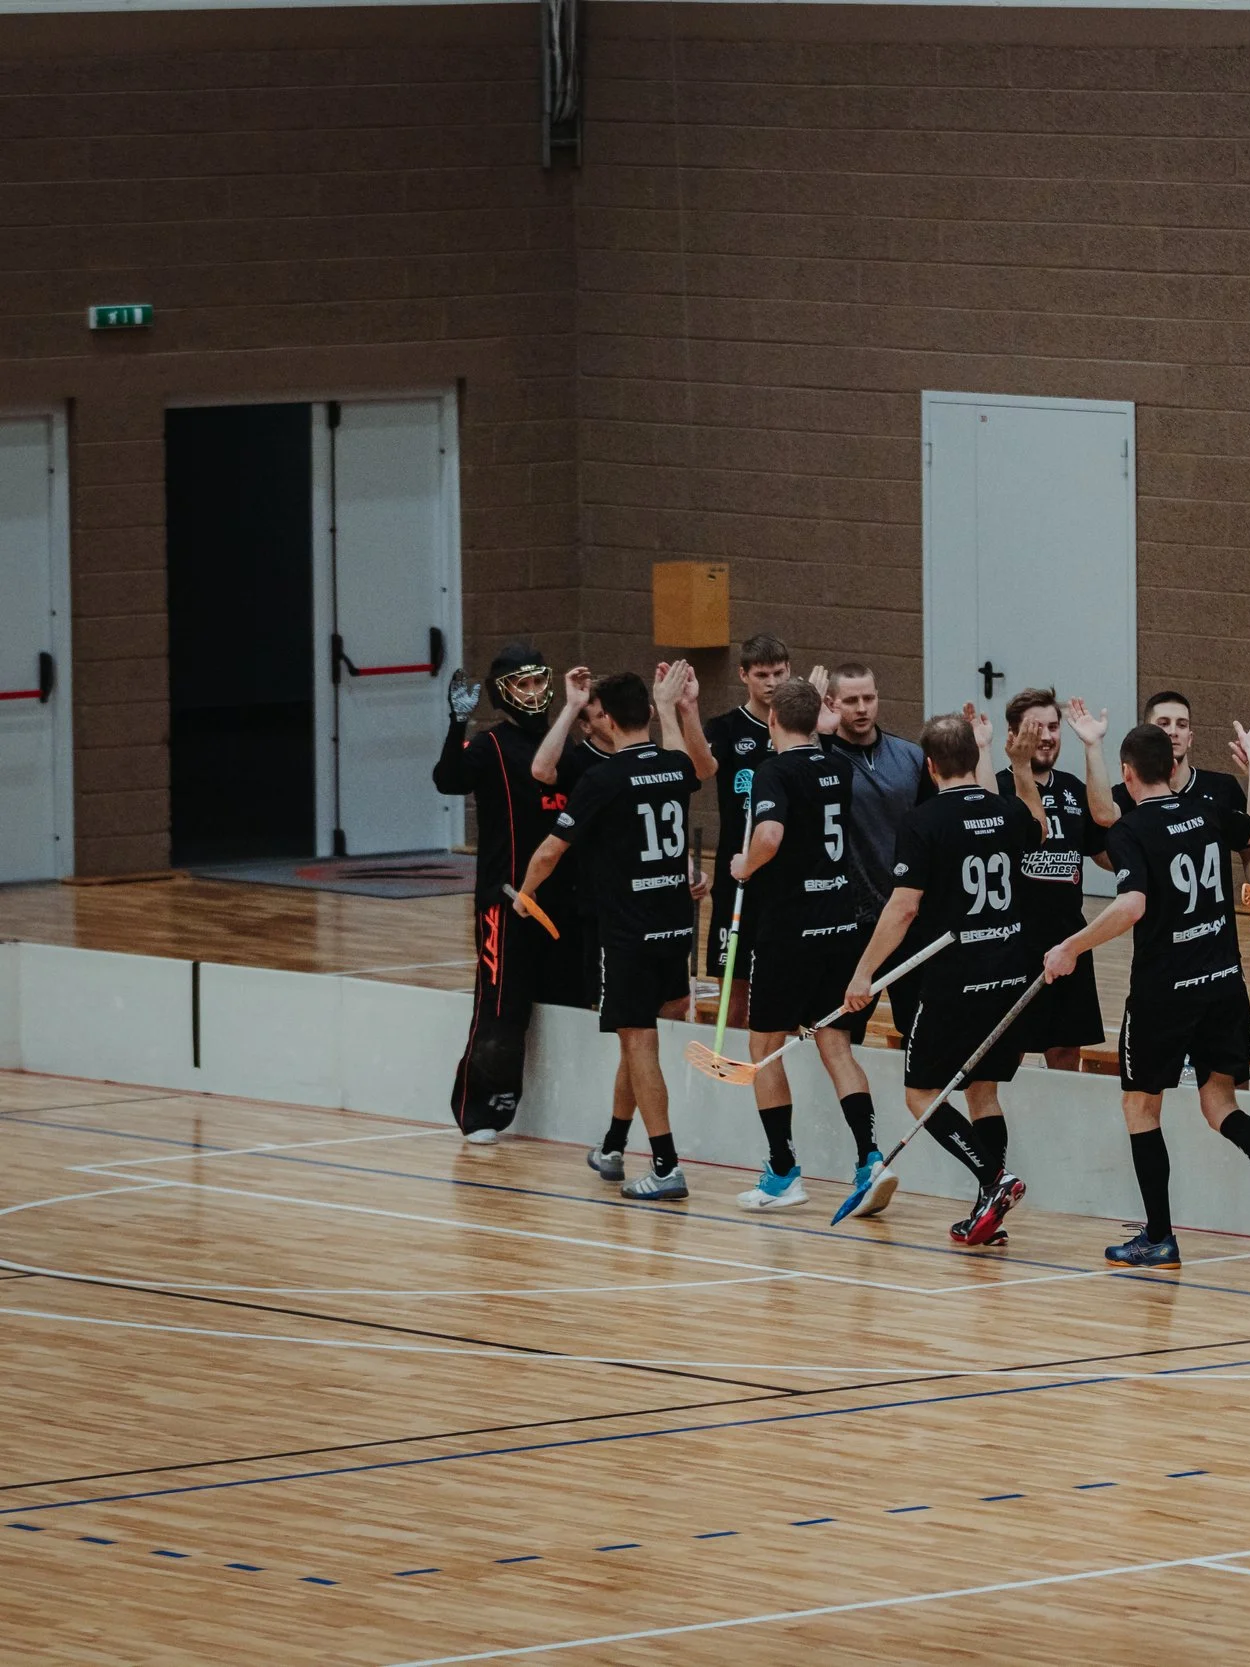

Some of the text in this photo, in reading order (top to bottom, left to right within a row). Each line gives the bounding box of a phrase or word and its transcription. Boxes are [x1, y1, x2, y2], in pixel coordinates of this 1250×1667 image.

[739, 741, 755, 752] KSC
[638, 800, 684, 861] 13
[964, 816, 1004, 830] BRIEDIS
[1167, 817, 1204, 834] KOKINS
[825, 804, 843, 861] 5
[962, 852, 1011, 915] 93
[1170, 842, 1224, 914] 94
[643, 930, 674, 941] FAT
[802, 927, 835, 937] FAT
[1174, 963, 1240, 989] FAT PIPE
[963, 981, 999, 993] FAT
